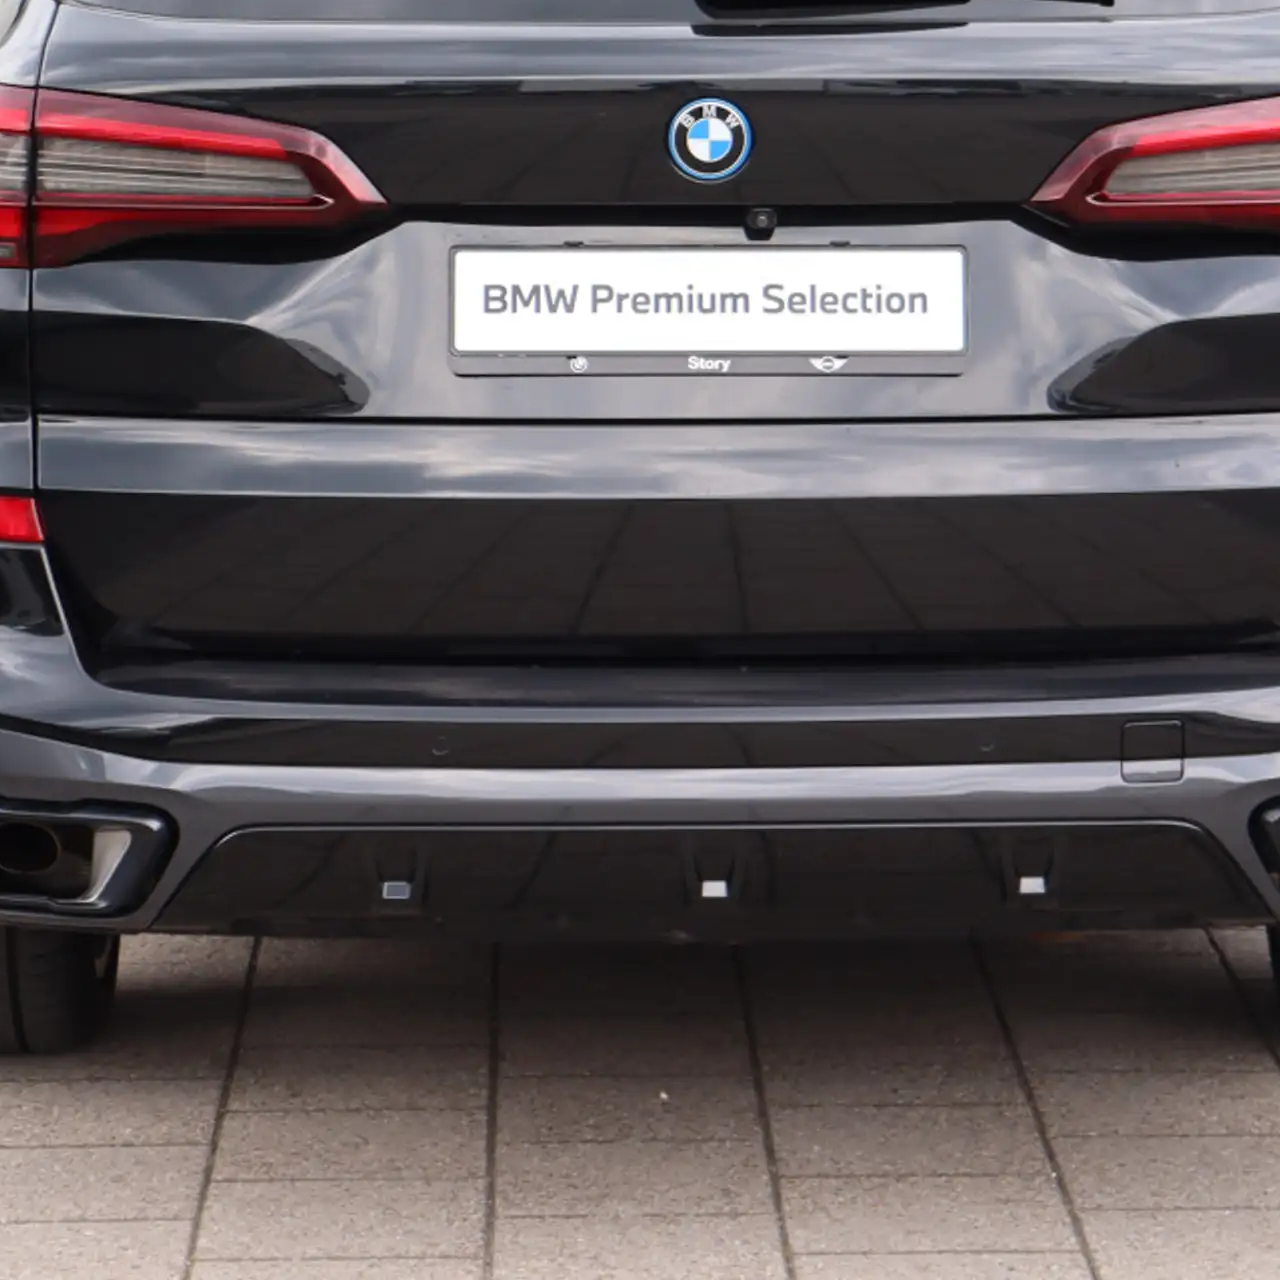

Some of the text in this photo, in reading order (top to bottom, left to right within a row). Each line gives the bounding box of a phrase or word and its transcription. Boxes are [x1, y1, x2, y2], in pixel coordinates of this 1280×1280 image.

[679, 104, 741, 129] BMW
[481, 283, 929, 315] BMW Premium Selection
[687, 355, 731, 372] Story
